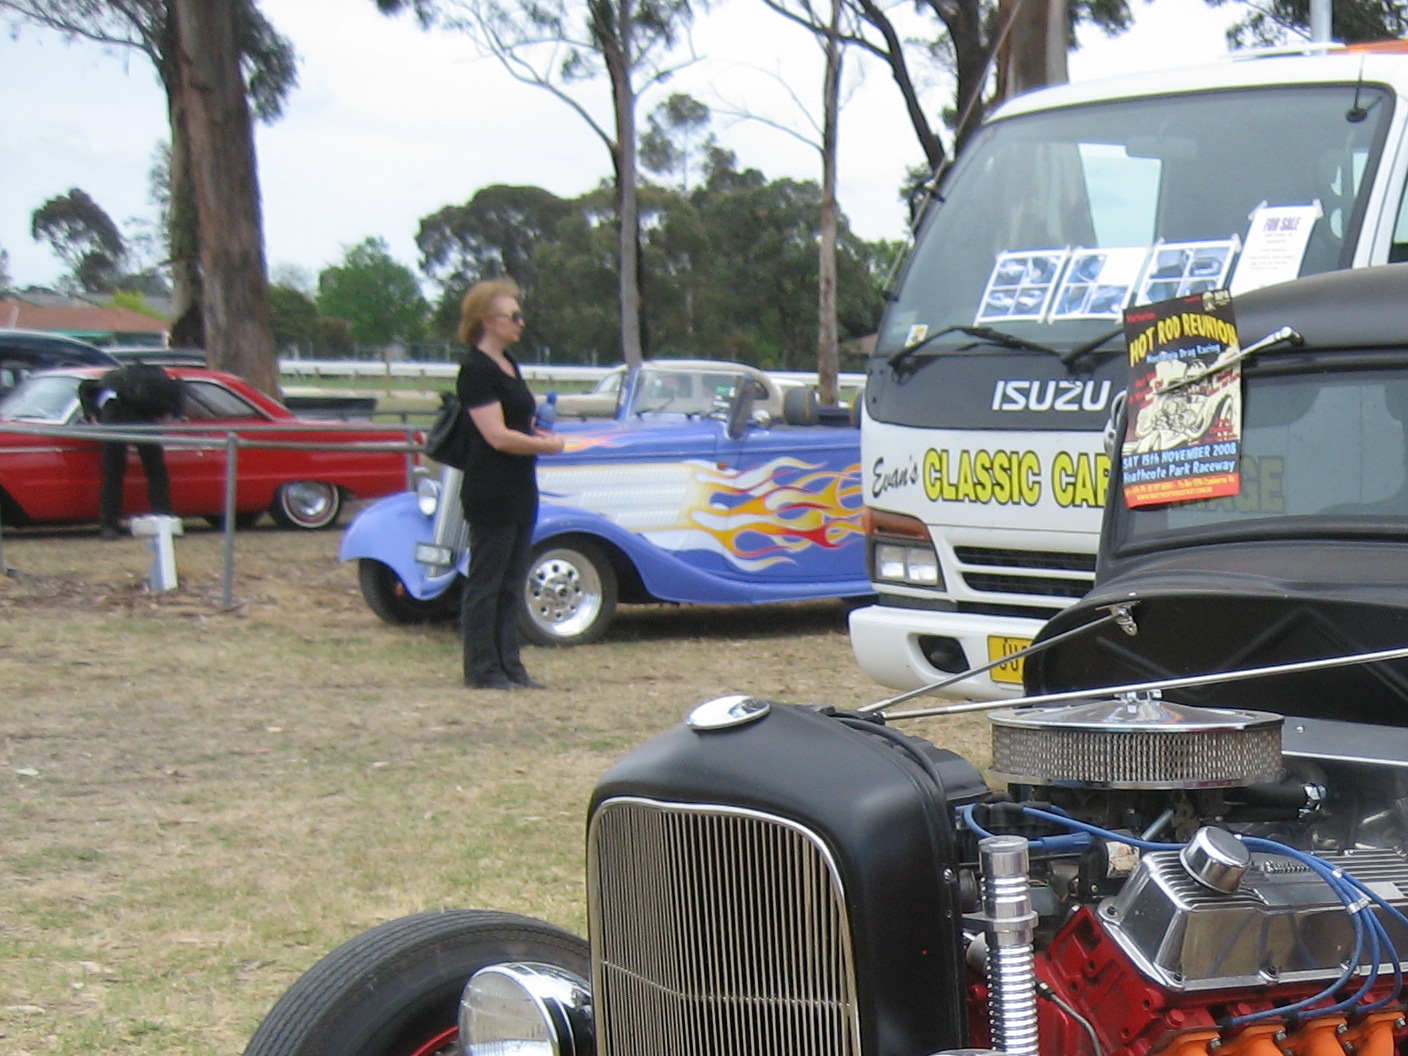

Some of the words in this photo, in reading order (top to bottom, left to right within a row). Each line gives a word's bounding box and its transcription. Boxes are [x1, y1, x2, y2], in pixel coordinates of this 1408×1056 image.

[1263, 217, 1280, 232] FOR
[1280, 216, 1302, 231] SALE
[1129, 326, 1156, 368] HOT
[1157, 315, 1181, 345] ROD
[1181, 313, 1238, 347] REUNION
[1179, 348, 1197, 359] Drag
[1197, 343, 1221, 355] Racing
[992, 380, 1111, 412] ISUZU
[1123, 455, 1140, 469] SAT
[1142, 453, 1160, 466] 15th
[1162, 447, 1211, 463] NOVEMBER
[1212, 442, 1237, 456] 2008
[871, 455, 919, 498] Evan's
[922, 447, 1042, 506] CLASSIC
[1124, 466, 1167, 484] Heathcote
[1168, 463, 1191, 477] Park
[1193, 460, 1236, 474] Raceway
